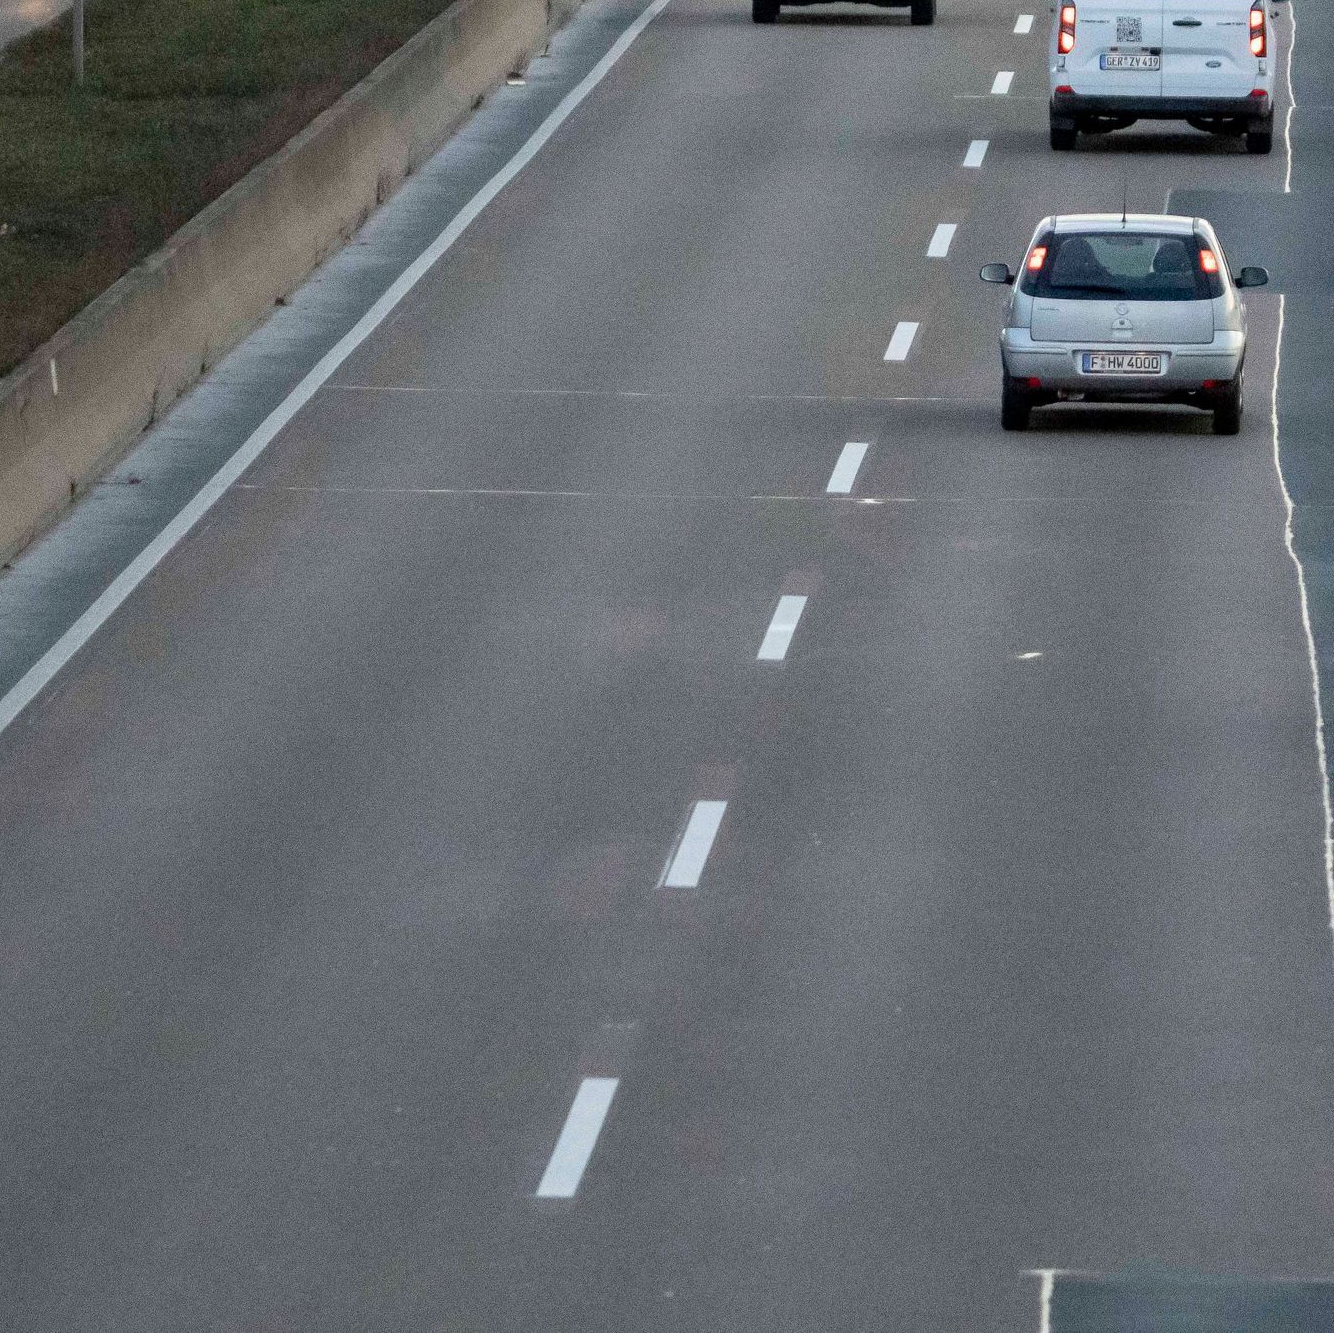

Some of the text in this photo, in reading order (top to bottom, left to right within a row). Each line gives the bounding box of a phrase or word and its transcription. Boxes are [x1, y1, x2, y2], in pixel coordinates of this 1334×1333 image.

[1106, 56, 1123, 66] GER
[1142, 57, 1158, 67] 419
[1091, 356, 1159, 369] F HW 4000
